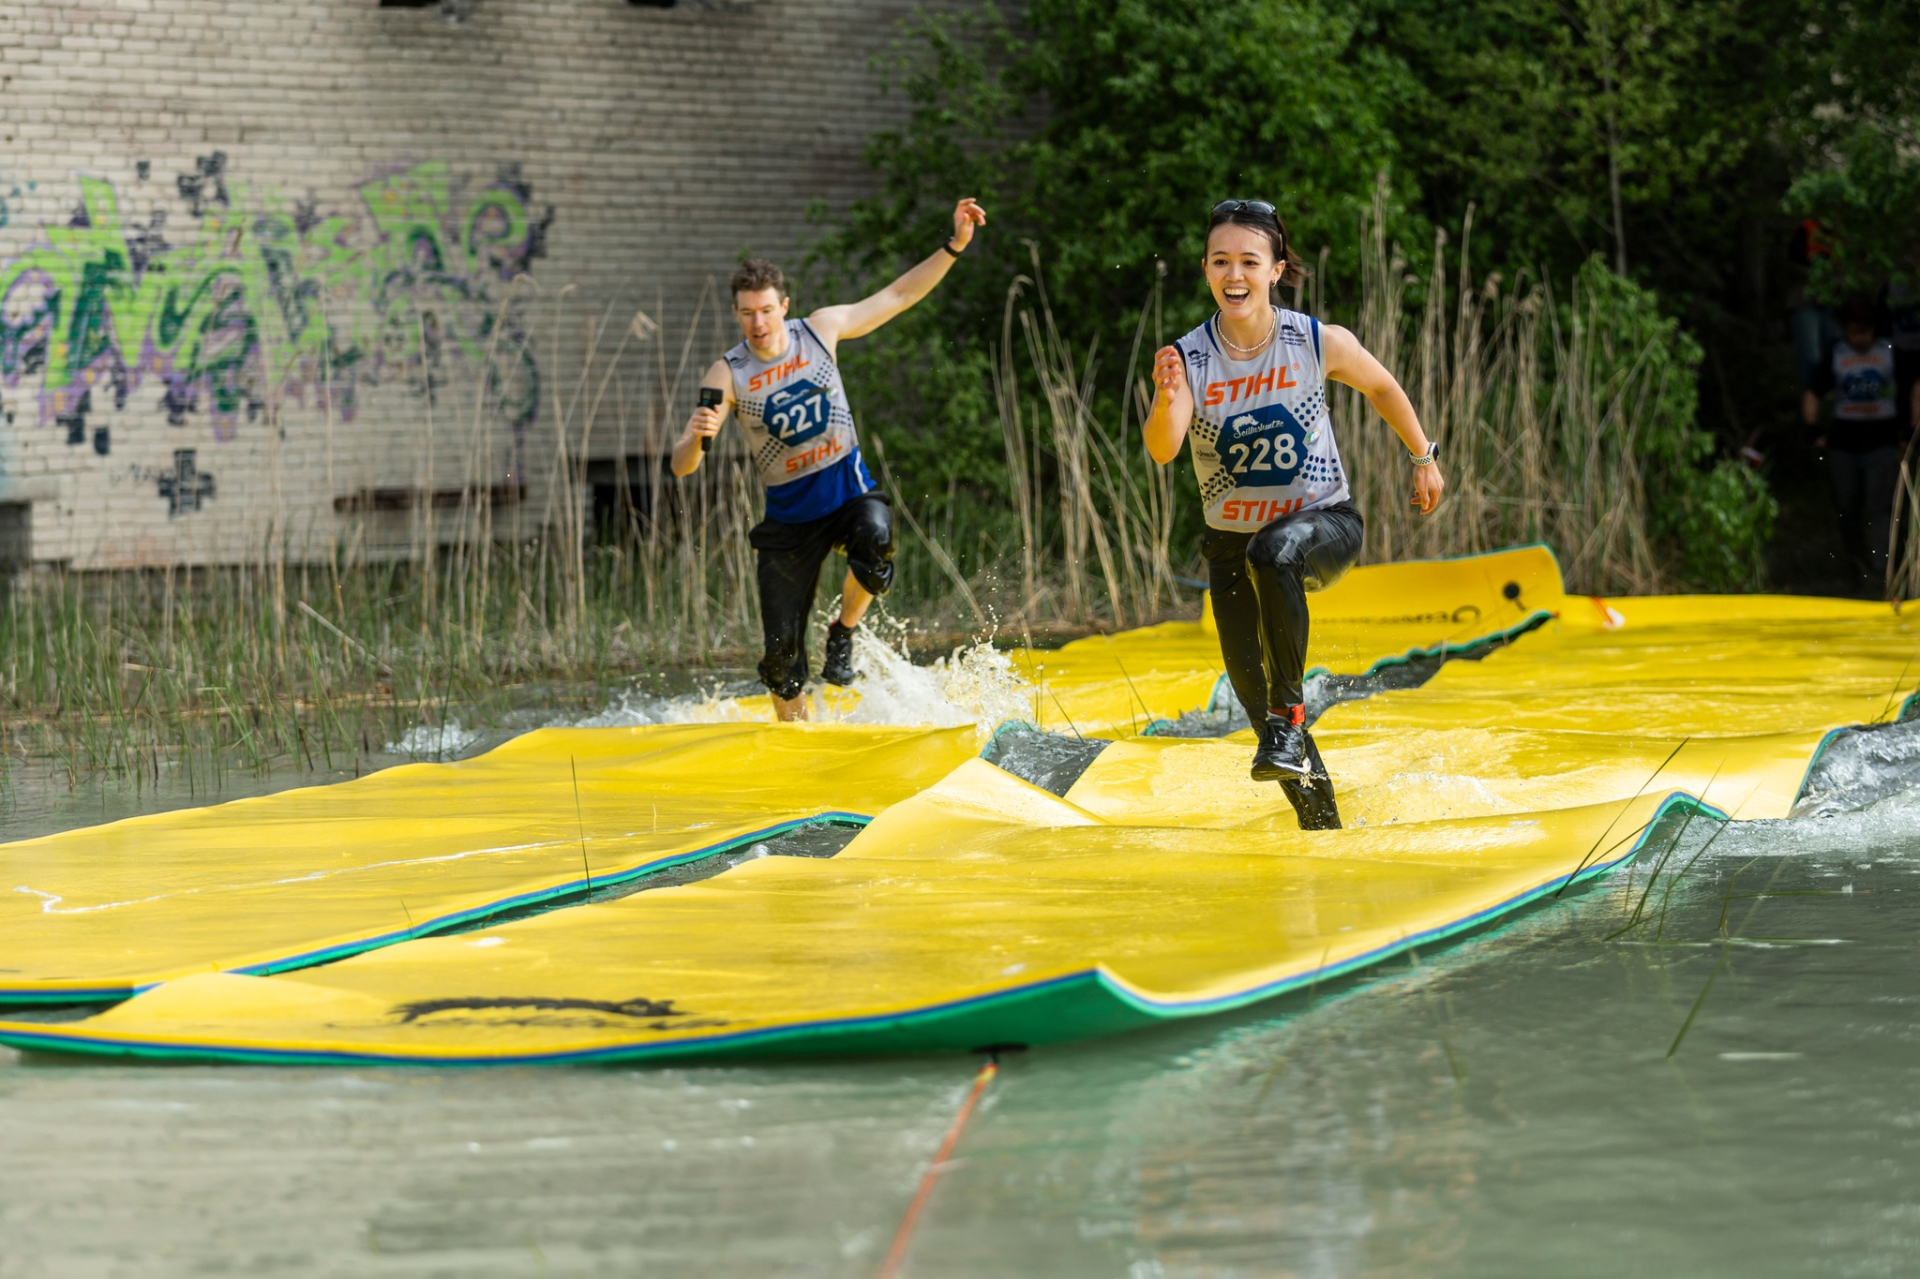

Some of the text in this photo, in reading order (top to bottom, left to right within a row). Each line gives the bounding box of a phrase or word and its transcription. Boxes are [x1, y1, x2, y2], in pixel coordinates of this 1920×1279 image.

[749, 354, 810, 393] STIHL
[1204, 366, 1297, 407] STIHL
[772, 394, 823, 440] 227
[785, 437, 843, 474] STIHL
[1228, 433, 1298, 474] 228
